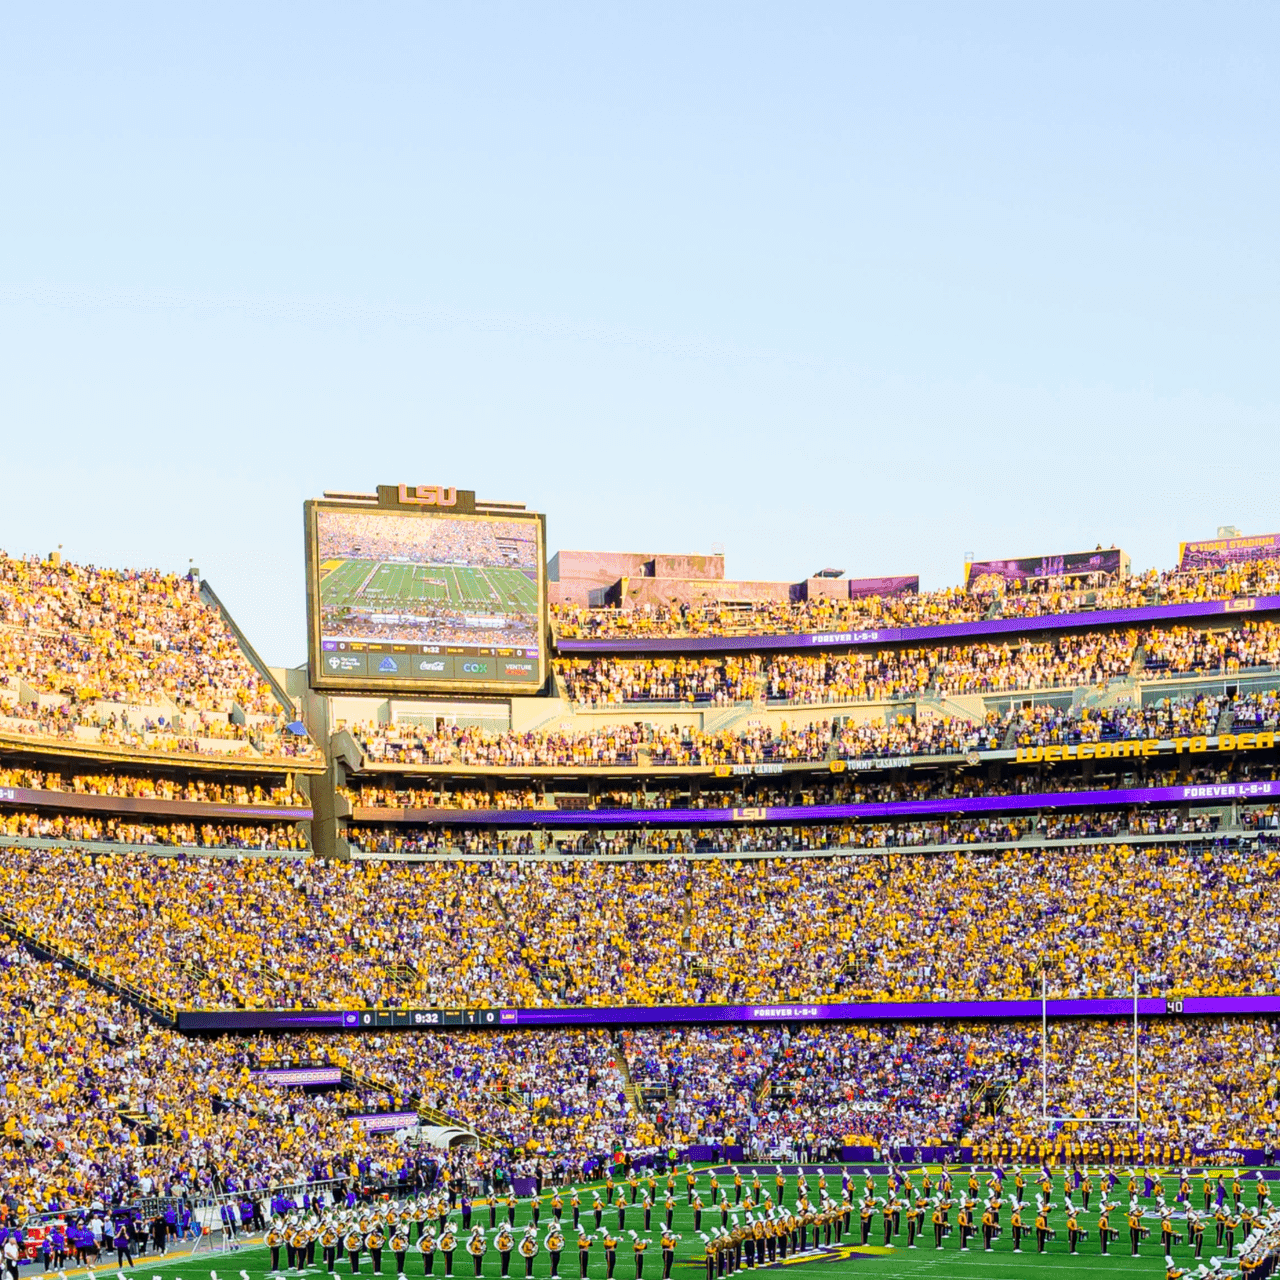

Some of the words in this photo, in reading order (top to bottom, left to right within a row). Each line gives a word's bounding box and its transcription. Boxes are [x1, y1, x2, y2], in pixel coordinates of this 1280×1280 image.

[398, 483, 456, 507] LSU
[1199, 541, 1227, 551] TIGER
[1229, 537, 1275, 549] STADIUM
[1225, 599, 1256, 612] LSU
[812, 634, 852, 644] FOREVER
[854, 632, 878, 641] L-S-U
[463, 663, 487, 673] COX
[1016, 739, 1159, 763] WELCOME
[1171, 736, 1207, 754] TO
[847, 761, 872, 770] TOMMY
[875, 758, 911, 768] CASANOVA
[1184, 786, 1236, 798] FOREVER
[1239, 785, 1271, 795] L-S-U
[733, 808, 766, 820] LSU
[1167, 1001, 1183, 1013] 40
[364, 1014, 370, 1024] 0
[415, 1013, 438, 1024] 9:32
[486, 1013, 494, 1022] 0
